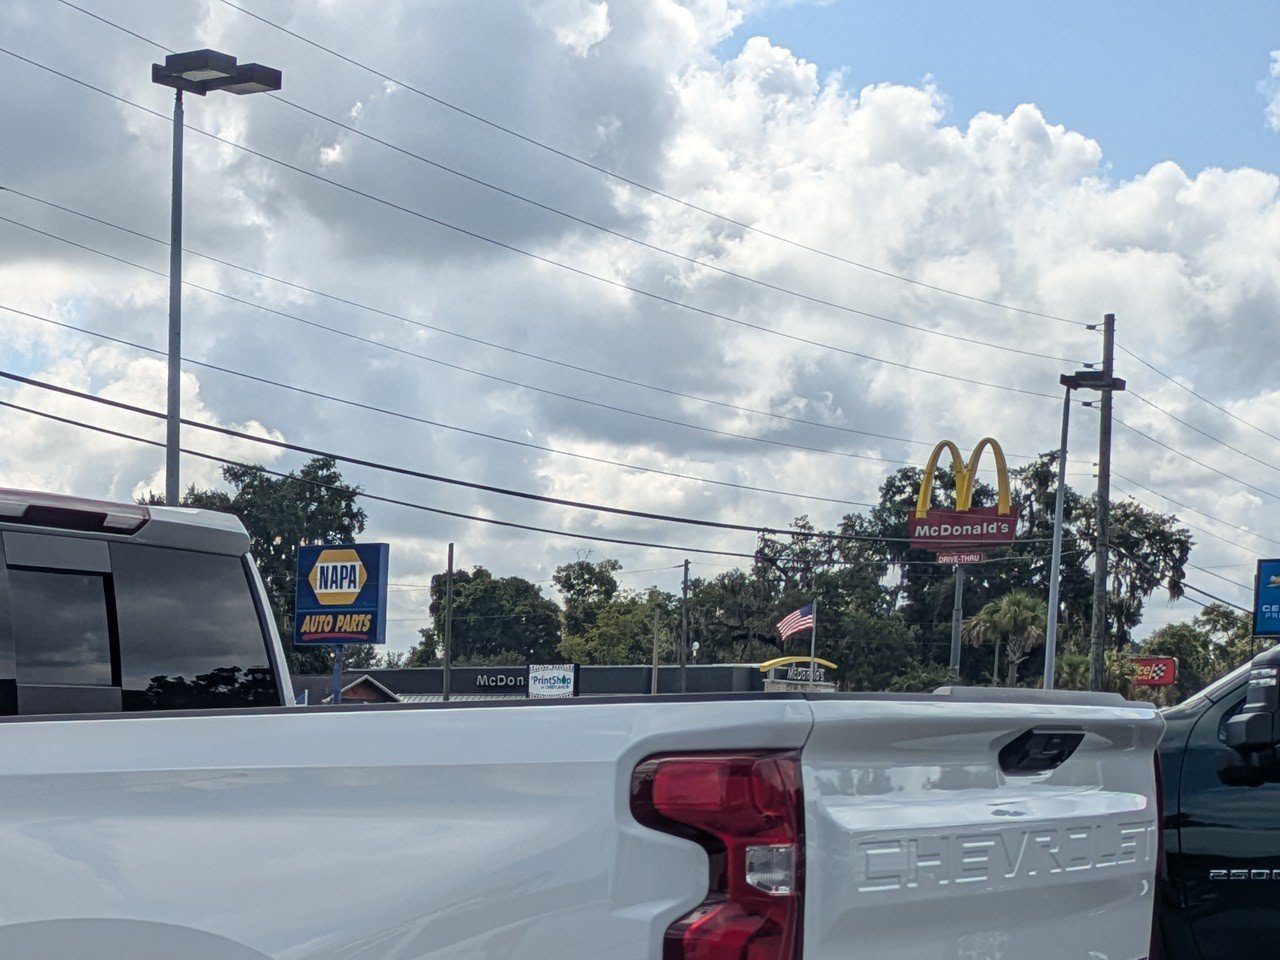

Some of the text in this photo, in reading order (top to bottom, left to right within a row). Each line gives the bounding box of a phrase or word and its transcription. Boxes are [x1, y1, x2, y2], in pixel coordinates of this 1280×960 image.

[915, 522, 1009, 537] McDonald's
[938, 554, 980, 563] DRIVE-THRU
[319, 564, 357, 590] NAPA
[300, 613, 372, 633] AUTO PARTS
[476, 675, 526, 686] McDon
[858, 820, 1156, 892] CHEVROLET
